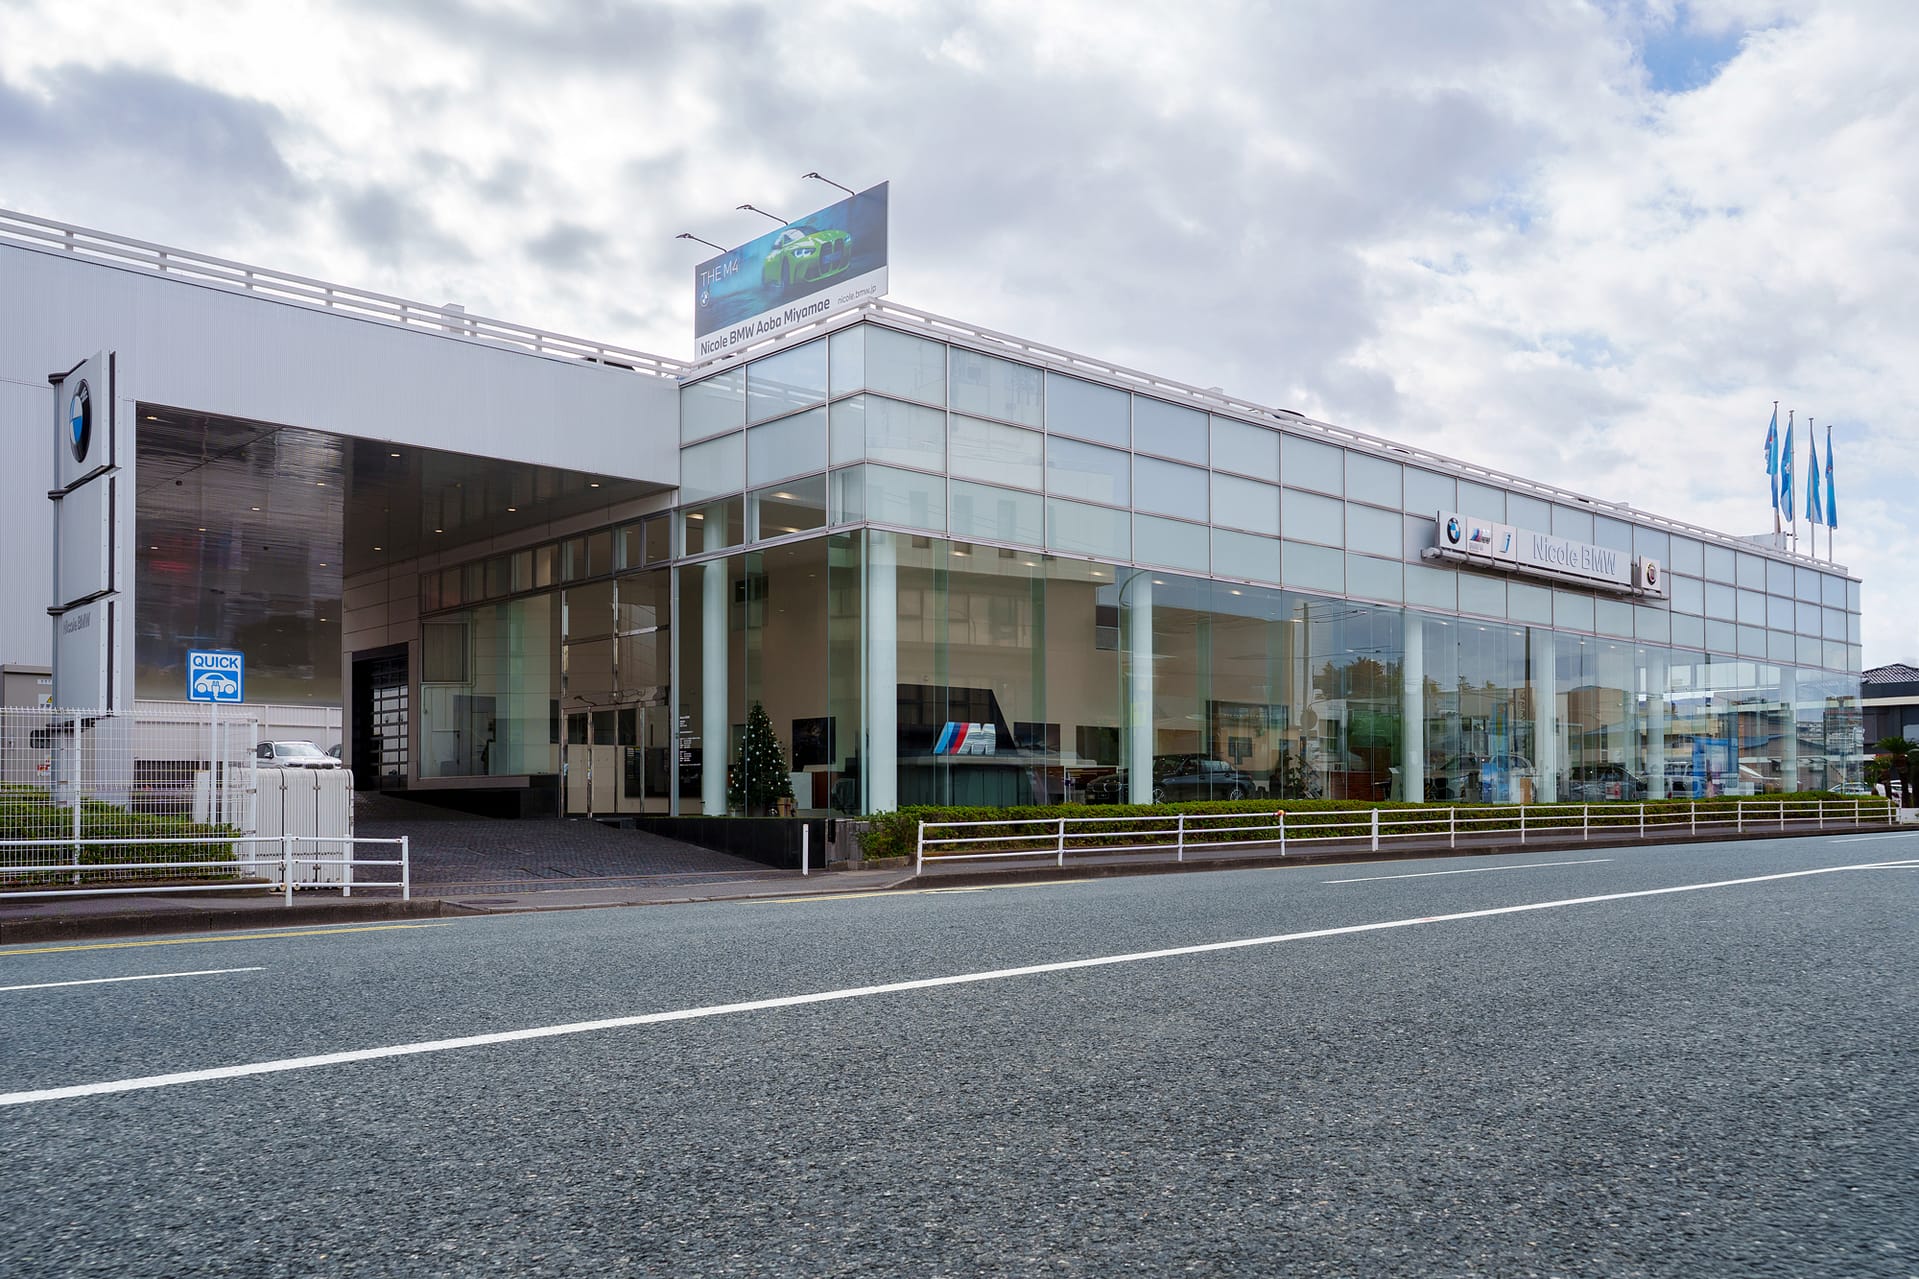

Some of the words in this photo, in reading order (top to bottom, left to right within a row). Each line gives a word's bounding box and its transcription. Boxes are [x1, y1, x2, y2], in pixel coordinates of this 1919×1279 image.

[700, 265, 721, 287] THE
[723, 258, 739, 279] M4
[837, 285, 877, 304] nicole.bmw.jp
[700, 336, 728, 356] Nicole
[729, 323, 755, 345] BMW
[756, 316, 782, 335] Aoba
[784, 298, 830, 323] Miyamae
[1533, 534, 1578, 568] Nicole
[1581, 544, 1616, 575] BMW
[193, 655, 239, 669] QUICK
